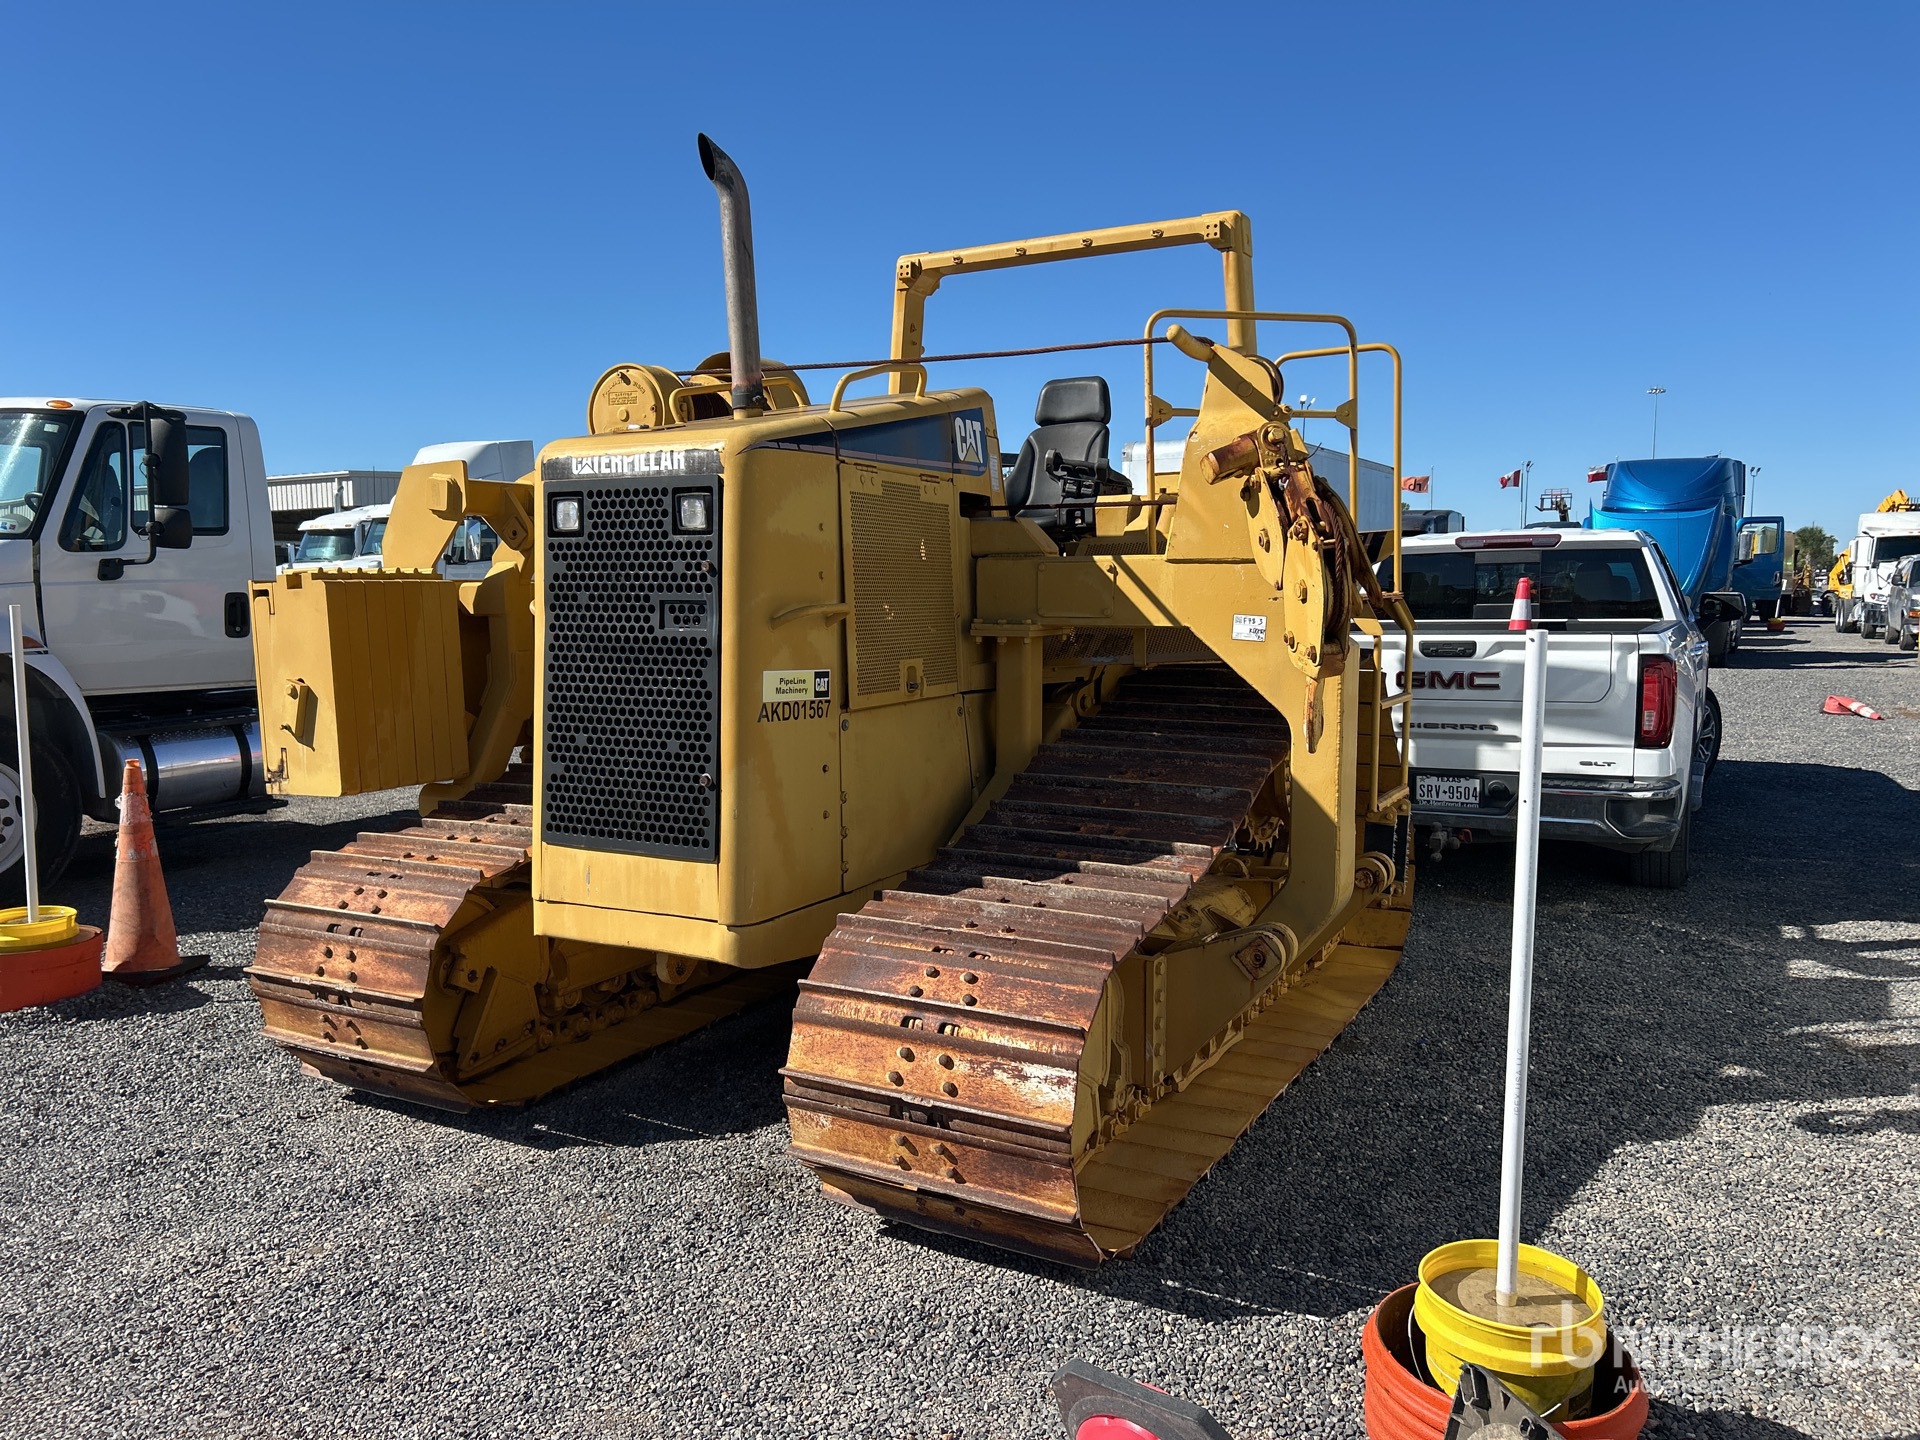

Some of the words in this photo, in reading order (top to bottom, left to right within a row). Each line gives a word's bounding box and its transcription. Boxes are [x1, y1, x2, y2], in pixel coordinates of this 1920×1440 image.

[954, 416, 983, 464] CAT
[571, 450, 686, 475] CATERPILLAR
[779, 677, 807, 686] PipeLine
[815, 678, 829, 691] CAT
[1396, 670, 1501, 690] GMC
[775, 686, 809, 695] Machinery
[757, 700, 831, 722] AKD01567
[1436, 776, 1462, 784] TEXAS
